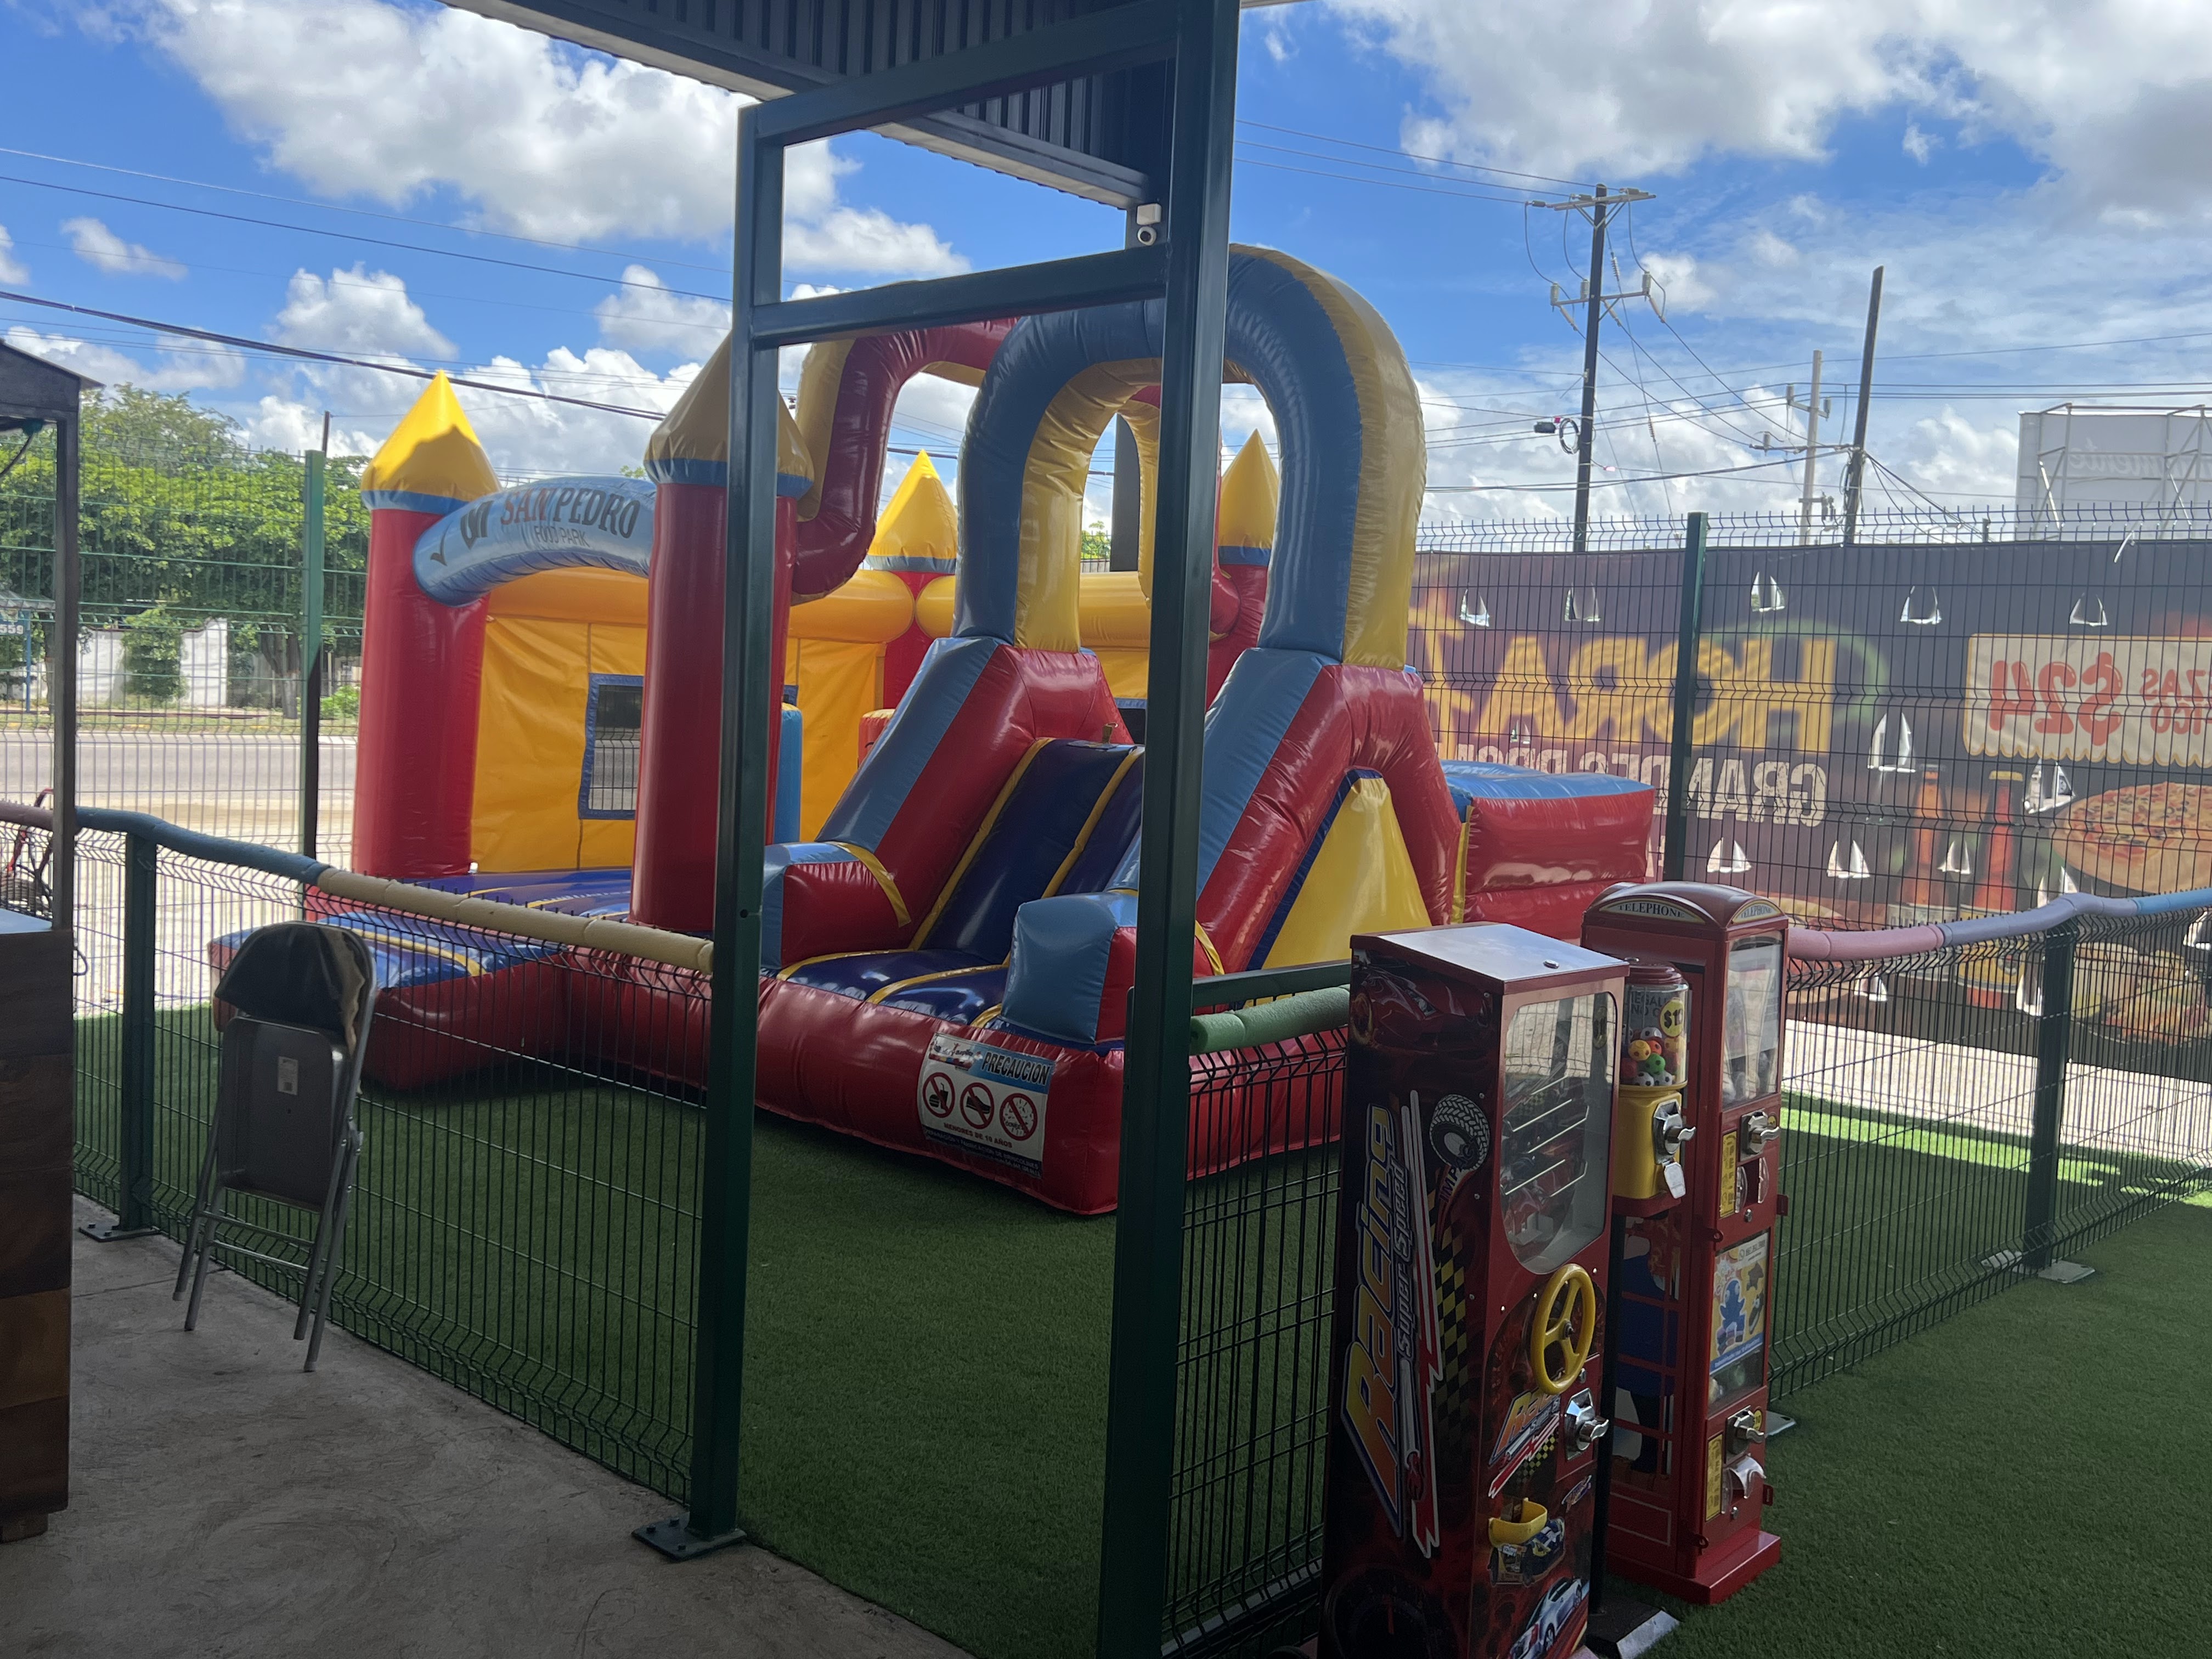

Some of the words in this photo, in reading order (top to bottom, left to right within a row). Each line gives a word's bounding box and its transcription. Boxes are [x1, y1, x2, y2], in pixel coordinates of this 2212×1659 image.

[500, 487, 556, 526] SAN
[553, 487, 641, 539] PEDRO
[534, 524, 560, 544] FOOD
[561, 527, 591, 548] PARK
[1618, 902, 1685, 918] TELEPHONE
[1741, 904, 1771, 919] TELEPHONE
[981, 1052, 1051, 1085] PRECAUCION
[1394, 1158, 1410, 1260] Speed
[1342, 1104, 1399, 1520] Racing
[1397, 1264, 1415, 1361] Super
